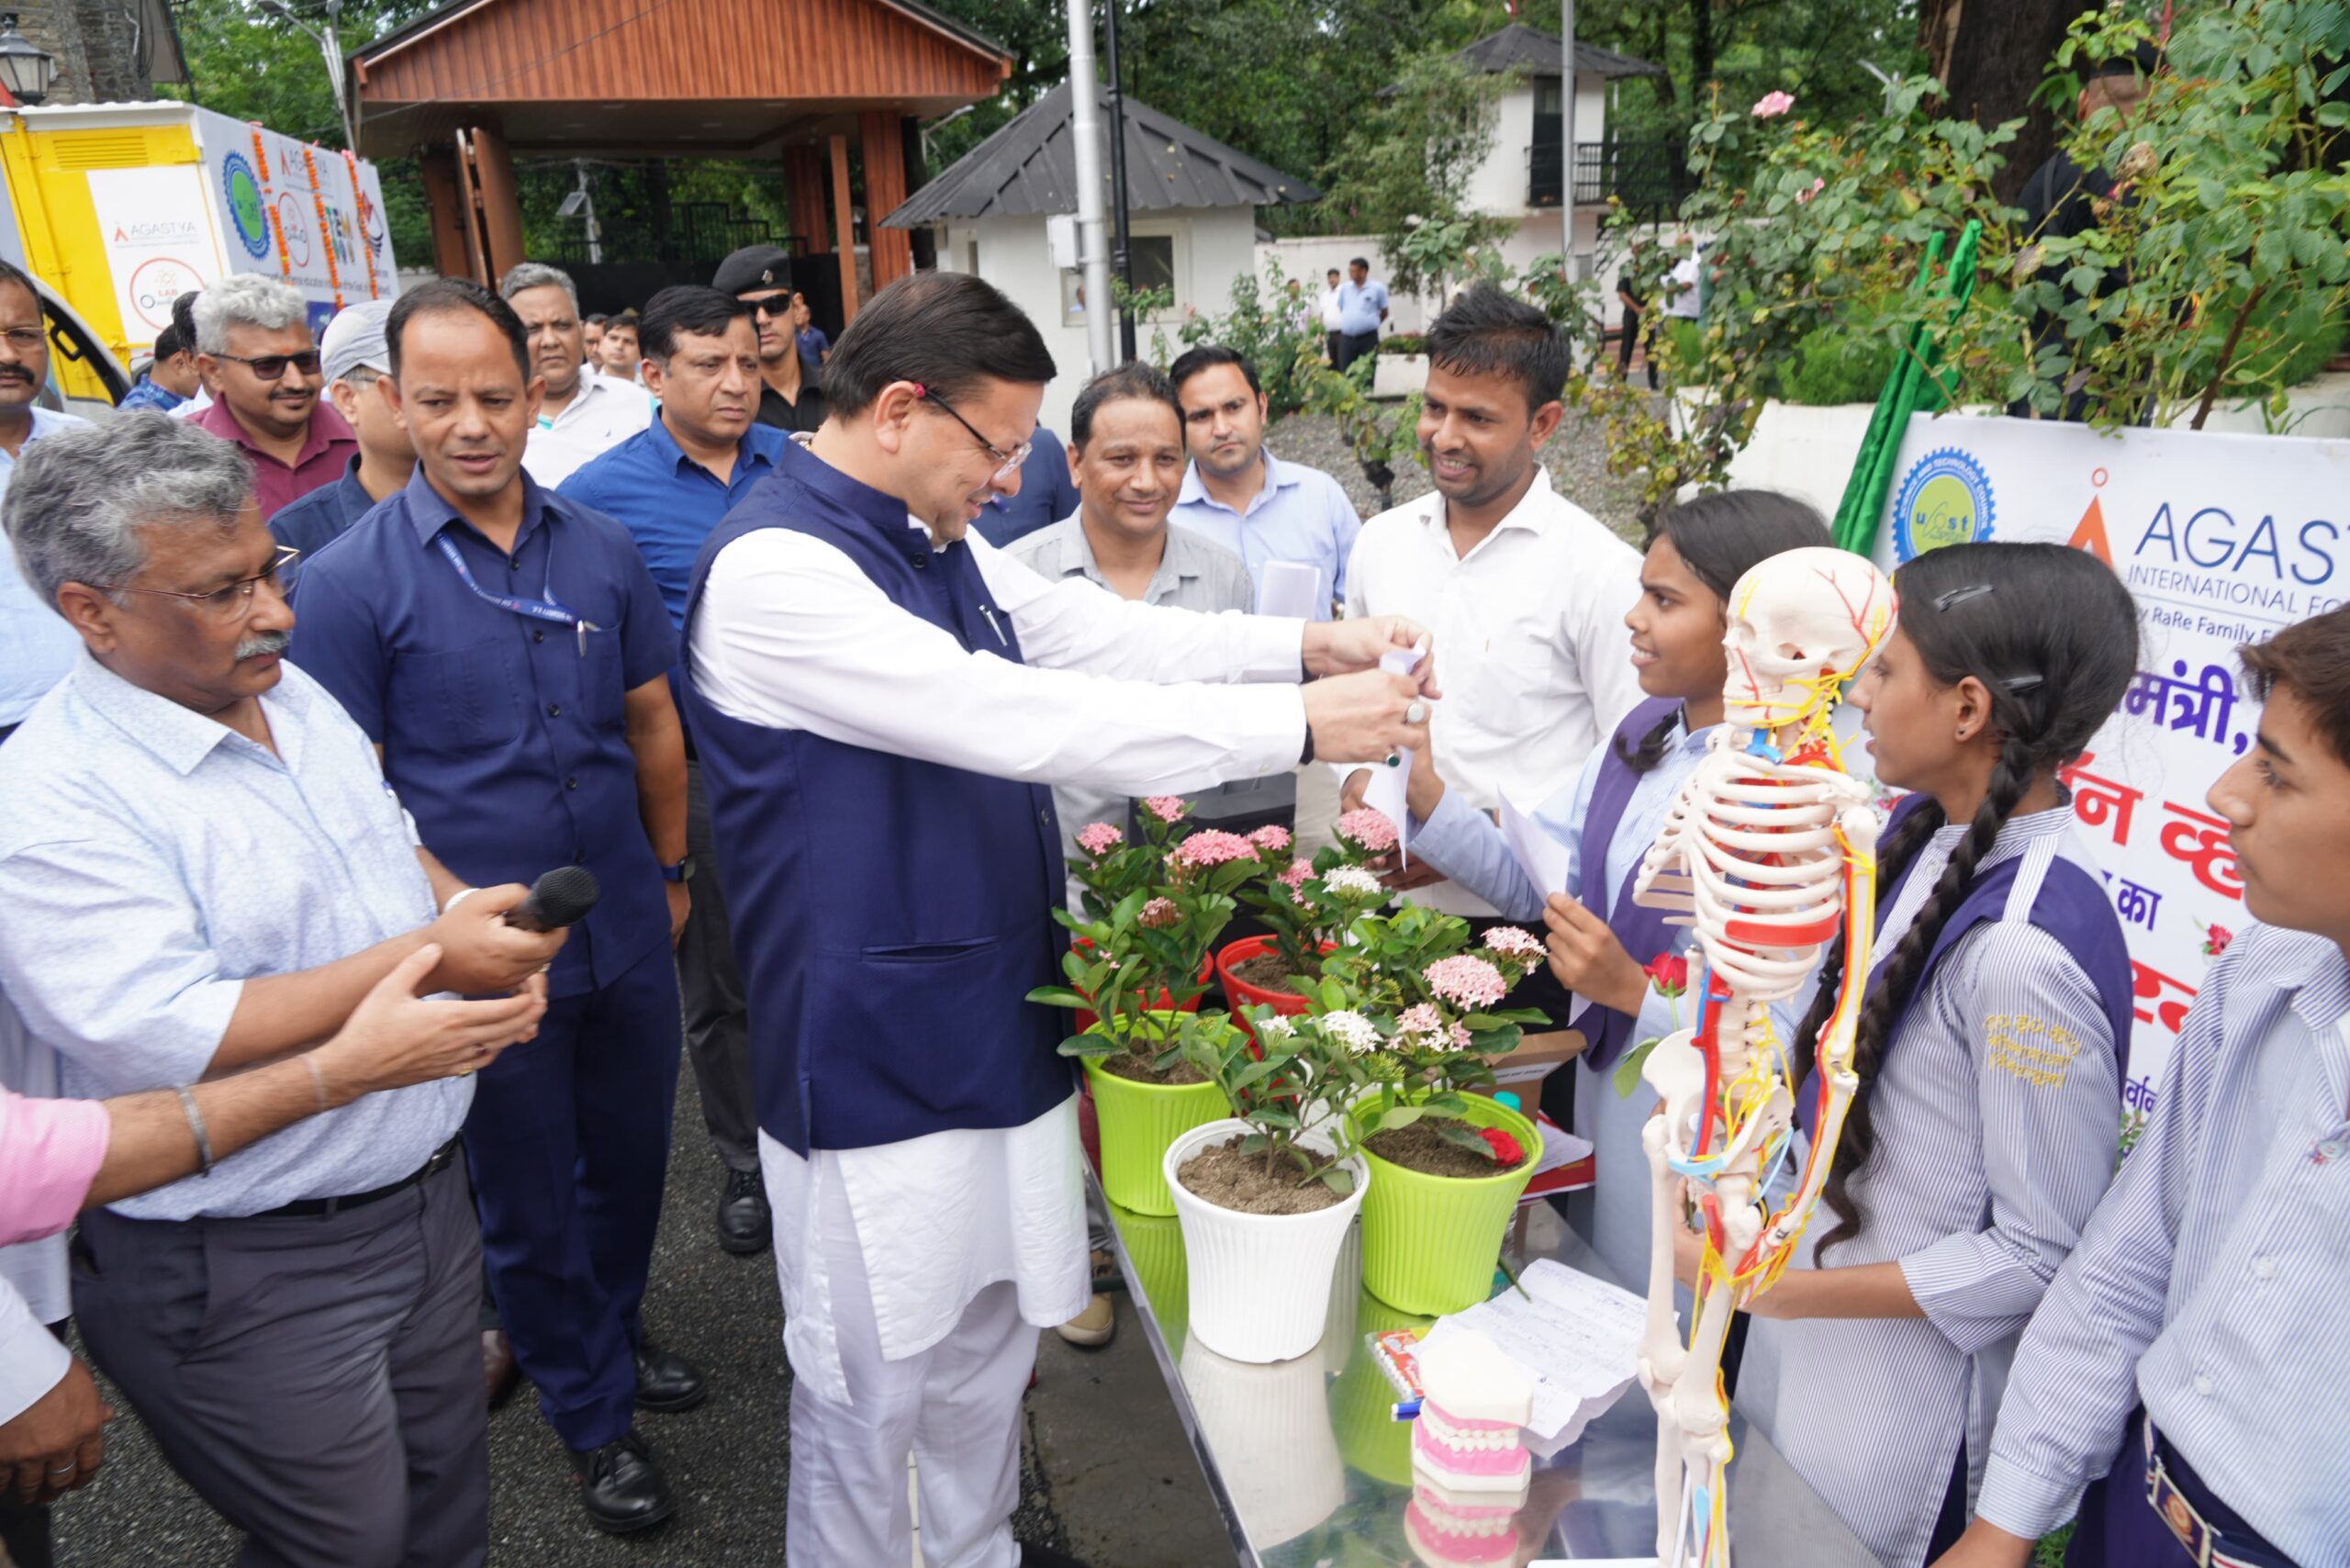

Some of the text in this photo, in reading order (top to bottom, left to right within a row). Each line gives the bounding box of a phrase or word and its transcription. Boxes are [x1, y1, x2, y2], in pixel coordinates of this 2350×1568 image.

[131, 221, 197, 236] AGASTYA
[2134, 502, 2350, 585] AGAS
[2128, 564, 2299, 614] INTERNATIONAL
[2152, 606, 2193, 632] RaRe
[2197, 616, 2255, 644] Family
[2115, 659, 2248, 756] मंत्री,
[2118, 878, 2163, 932] का
